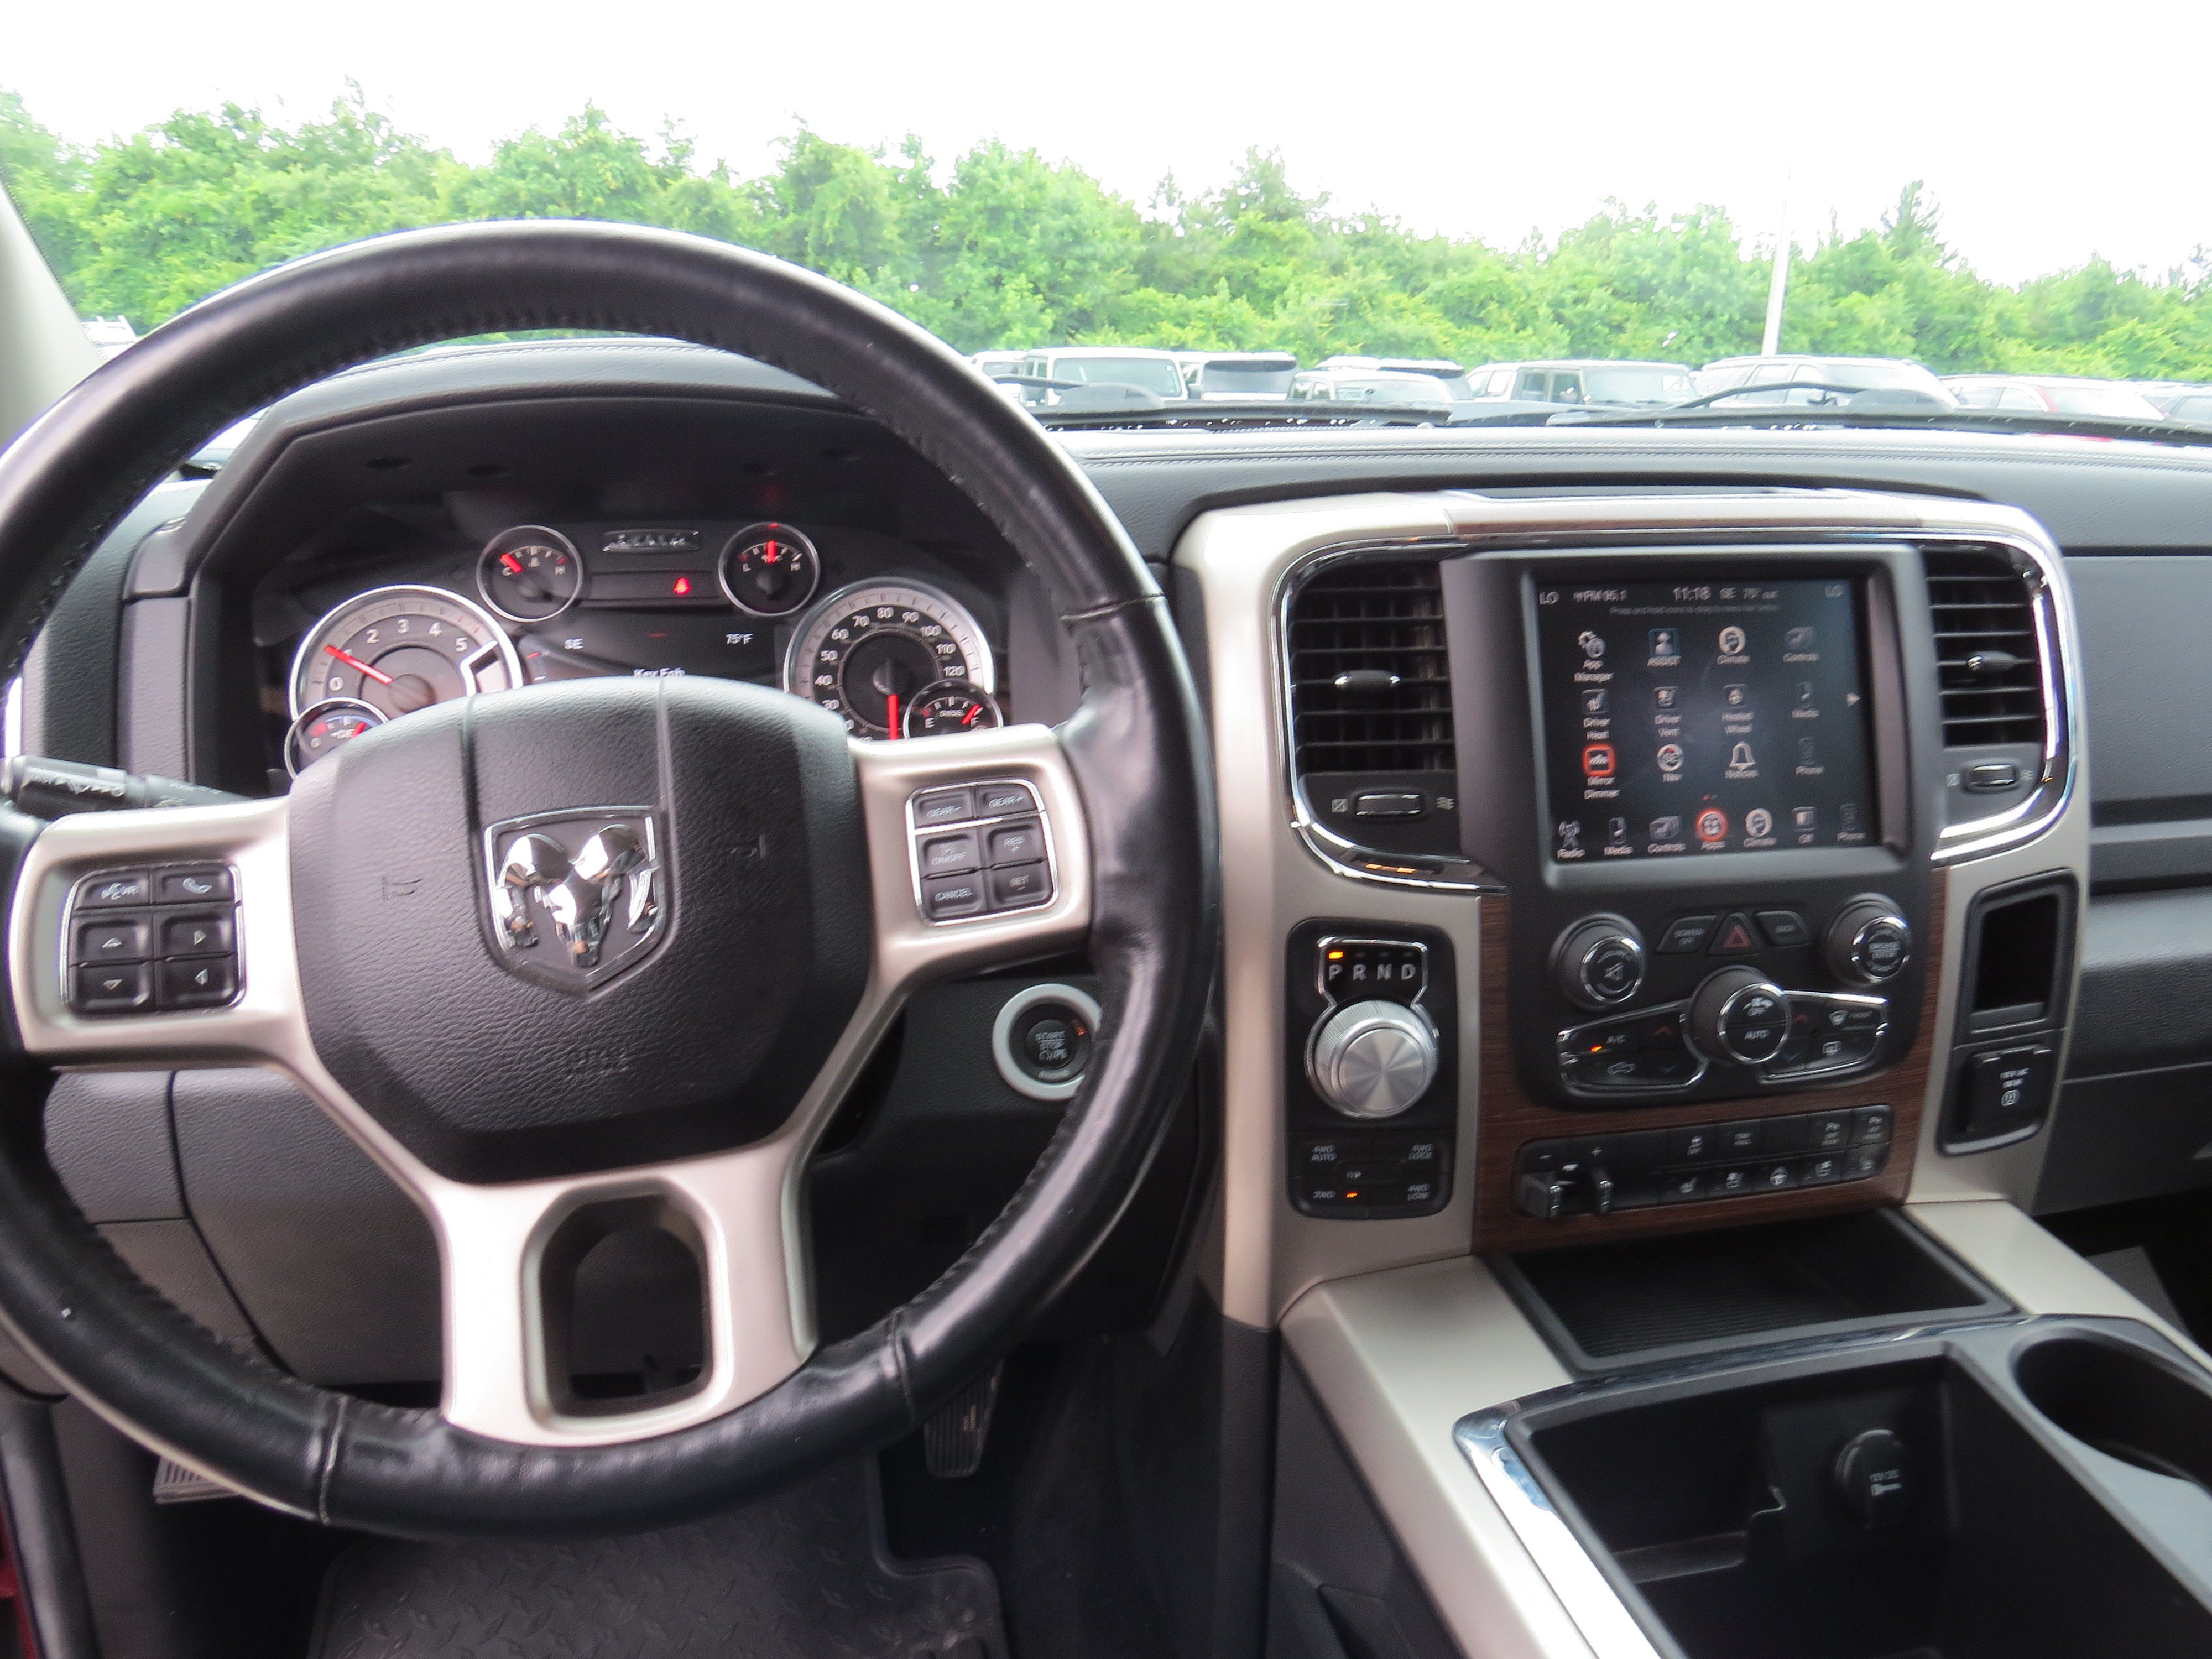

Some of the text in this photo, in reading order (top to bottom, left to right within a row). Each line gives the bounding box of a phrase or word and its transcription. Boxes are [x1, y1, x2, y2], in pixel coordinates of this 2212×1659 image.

[1539, 591, 1559, 605] LO
[1673, 586, 1712, 601] 11:18
[877, 607, 894, 619] 80
[902, 611, 919, 623] 90
[397, 619, 409, 633] 3
[852, 615, 870, 628] 70
[428, 622, 442, 637] 4
[831, 628, 849, 640] 60
[920, 625, 942, 637] 100
[366, 629, 379, 644] 2
[455, 637, 468, 652] 5
[565, 638, 583, 650] SE
[936, 643, 956, 655] 110
[820, 650, 838, 661] 50
[943, 665, 966, 677] 120
[330, 676, 343, 691] 0
[815, 674, 833, 687] 40
[822, 698, 840, 711] 30
[925, 718, 935, 728] E
[971, 717, 979, 727] F
[1009, 875, 1030, 888] SET
[935, 887, 973, 902] CANCEL
[1329, 963, 1417, 980] P R N D
[1745, 1030, 1770, 1040] AUTO
[1312, 1145, 1335, 1154] 4WD
[1411, 1144, 1434, 1152] 4WD
[1311, 1153, 1337, 1161] AUTO
[1407, 1183, 1431, 1192] 4WD
[1313, 1190, 1336, 1199] 2WD
